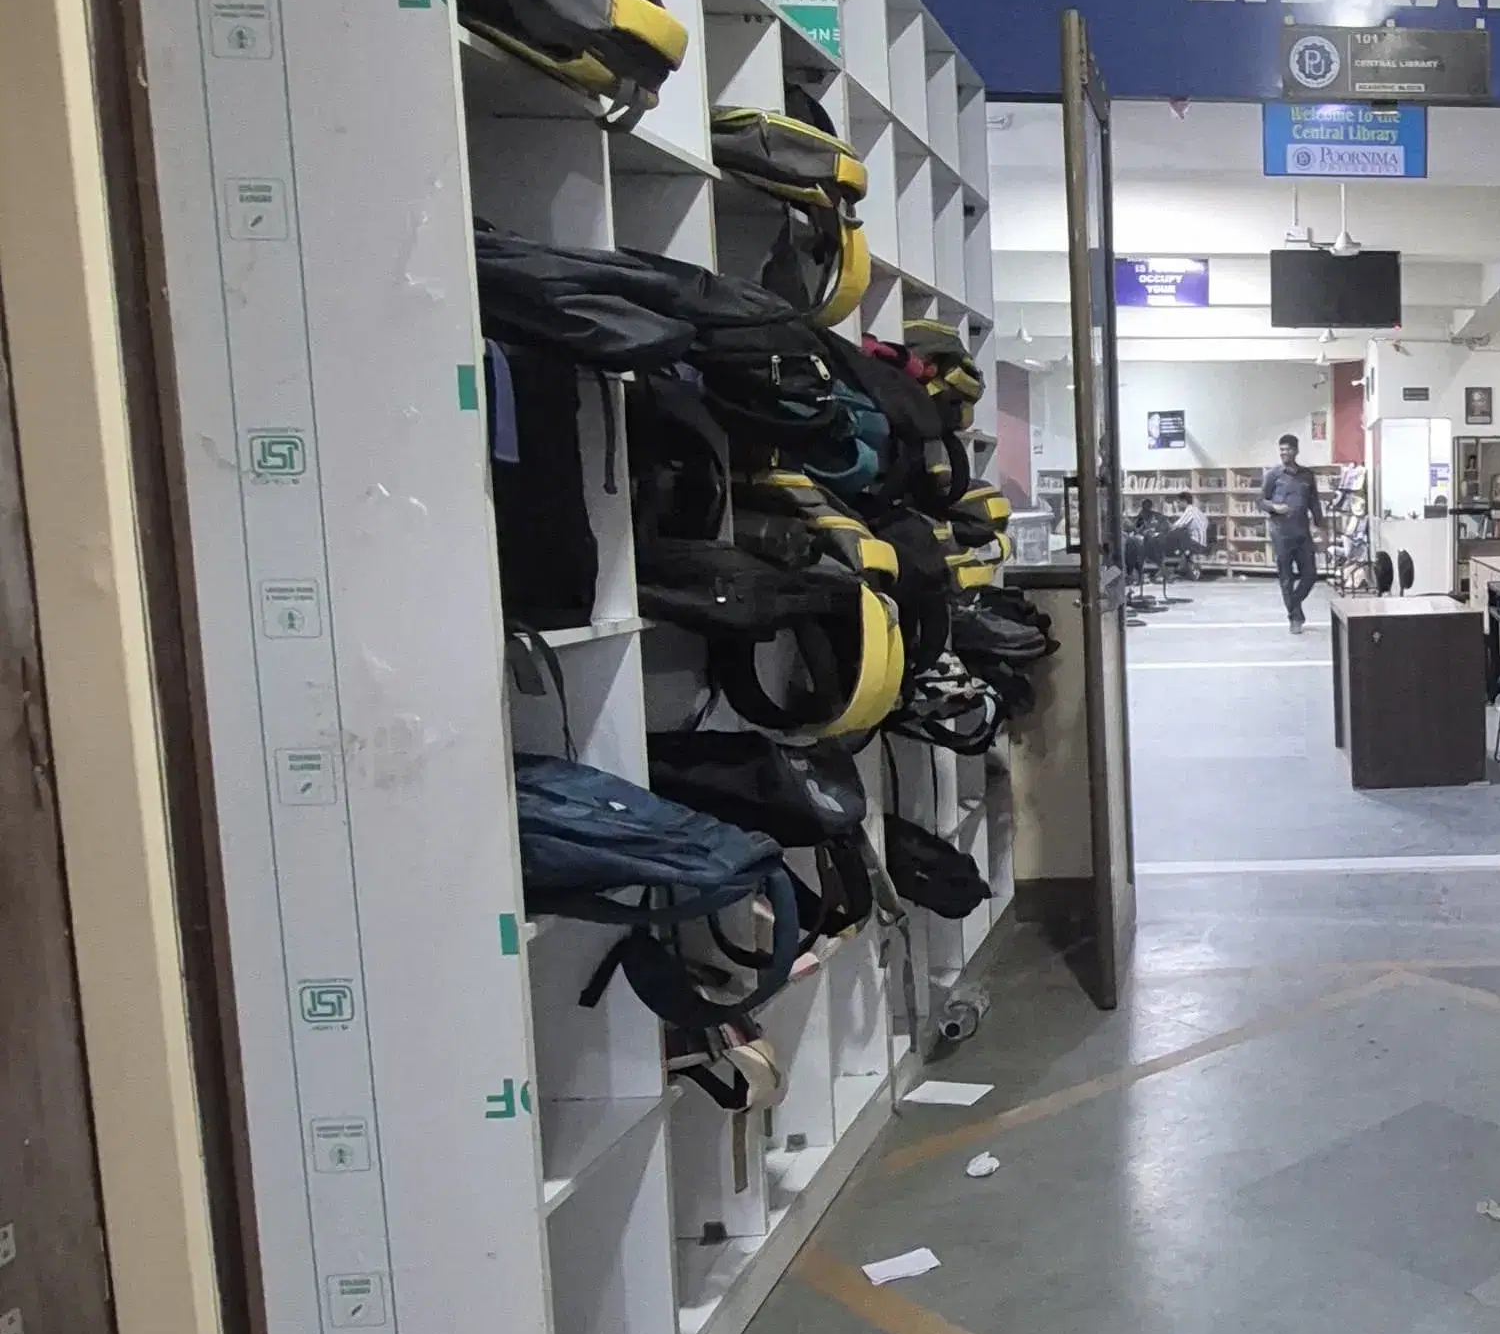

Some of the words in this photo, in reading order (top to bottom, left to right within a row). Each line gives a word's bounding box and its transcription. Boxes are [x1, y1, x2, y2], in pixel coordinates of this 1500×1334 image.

[1354, 59, 1397, 68] CENTRAL
[1399, 59, 1438, 68] LIBRARY
[1291, 106, 1354, 122] Welcome
[1358, 108, 1373, 122] to
[1292, 124, 1345, 140] Central
[1348, 125, 1399, 144] Library
